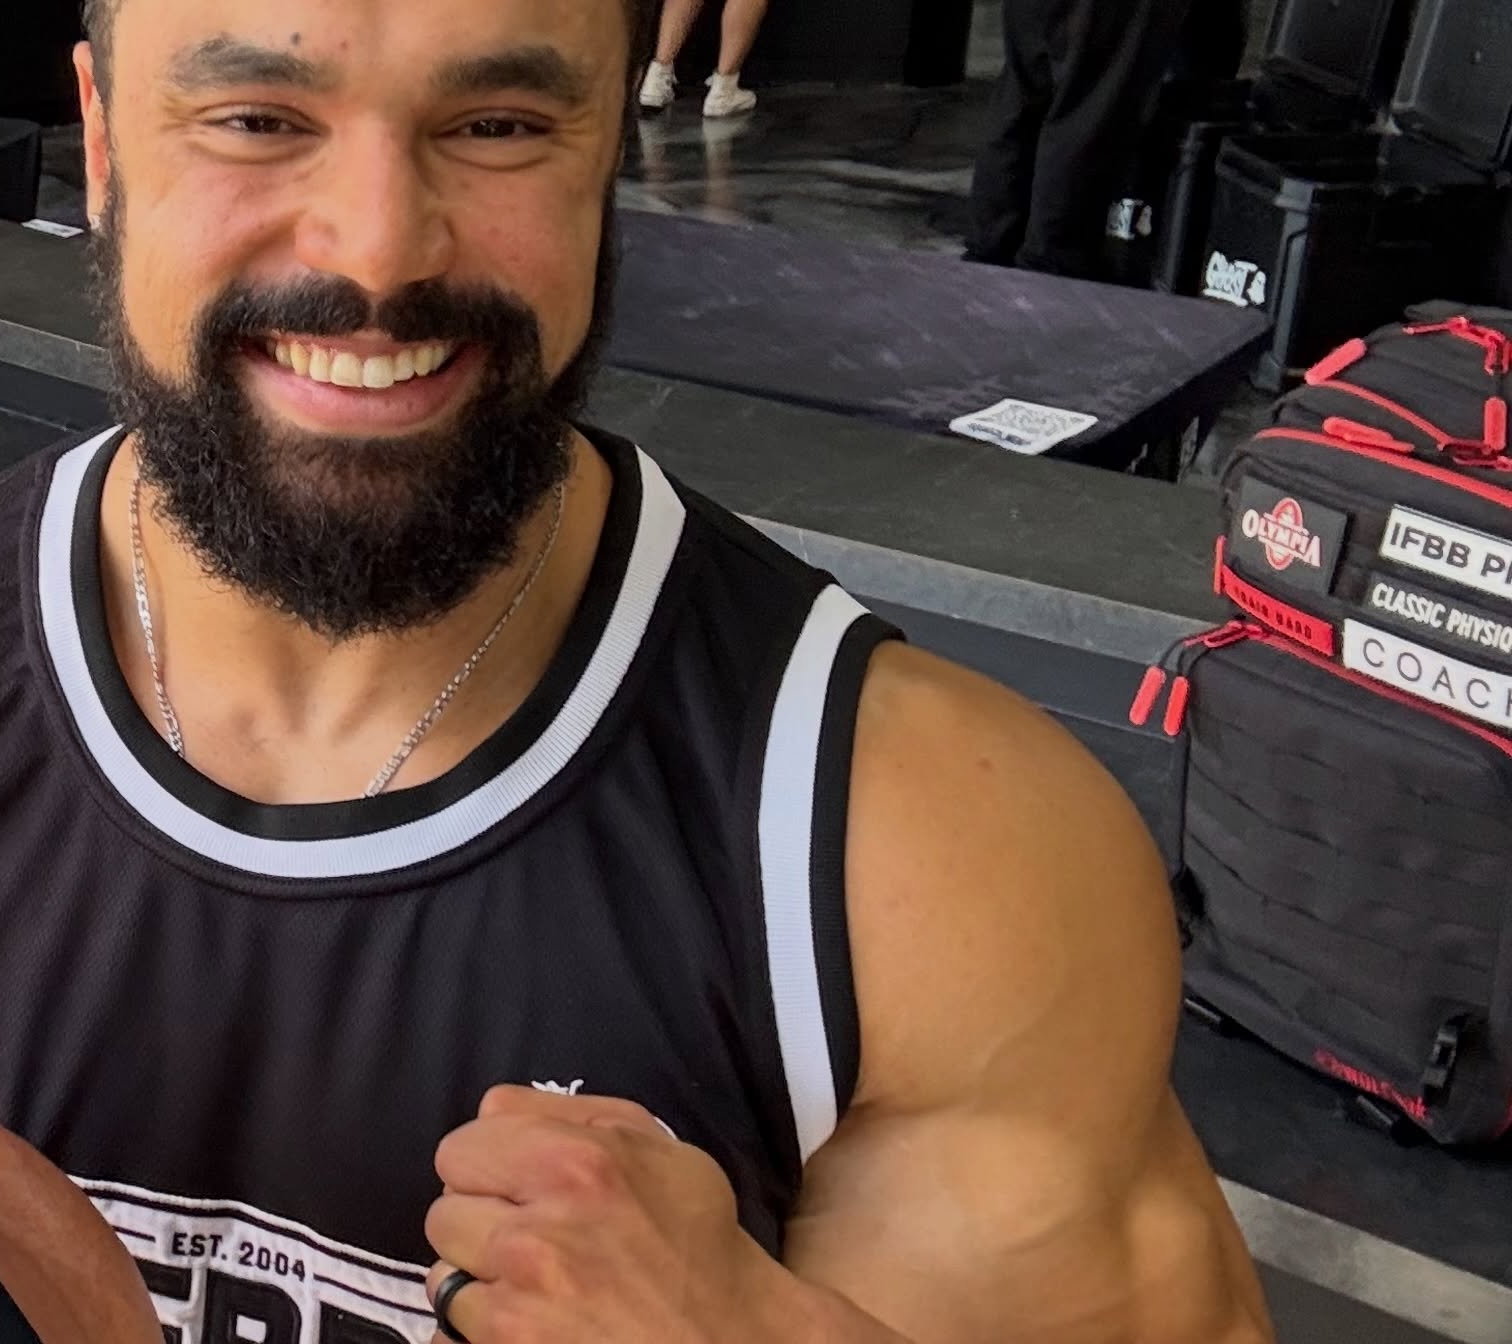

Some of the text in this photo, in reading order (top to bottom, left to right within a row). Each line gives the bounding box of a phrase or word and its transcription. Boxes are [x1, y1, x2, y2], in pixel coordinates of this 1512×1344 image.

[1390, 522, 1472, 569] IFBB
[1372, 582, 1446, 629] CLASSIC
[171, 1232, 307, 1282] EST. 2004
